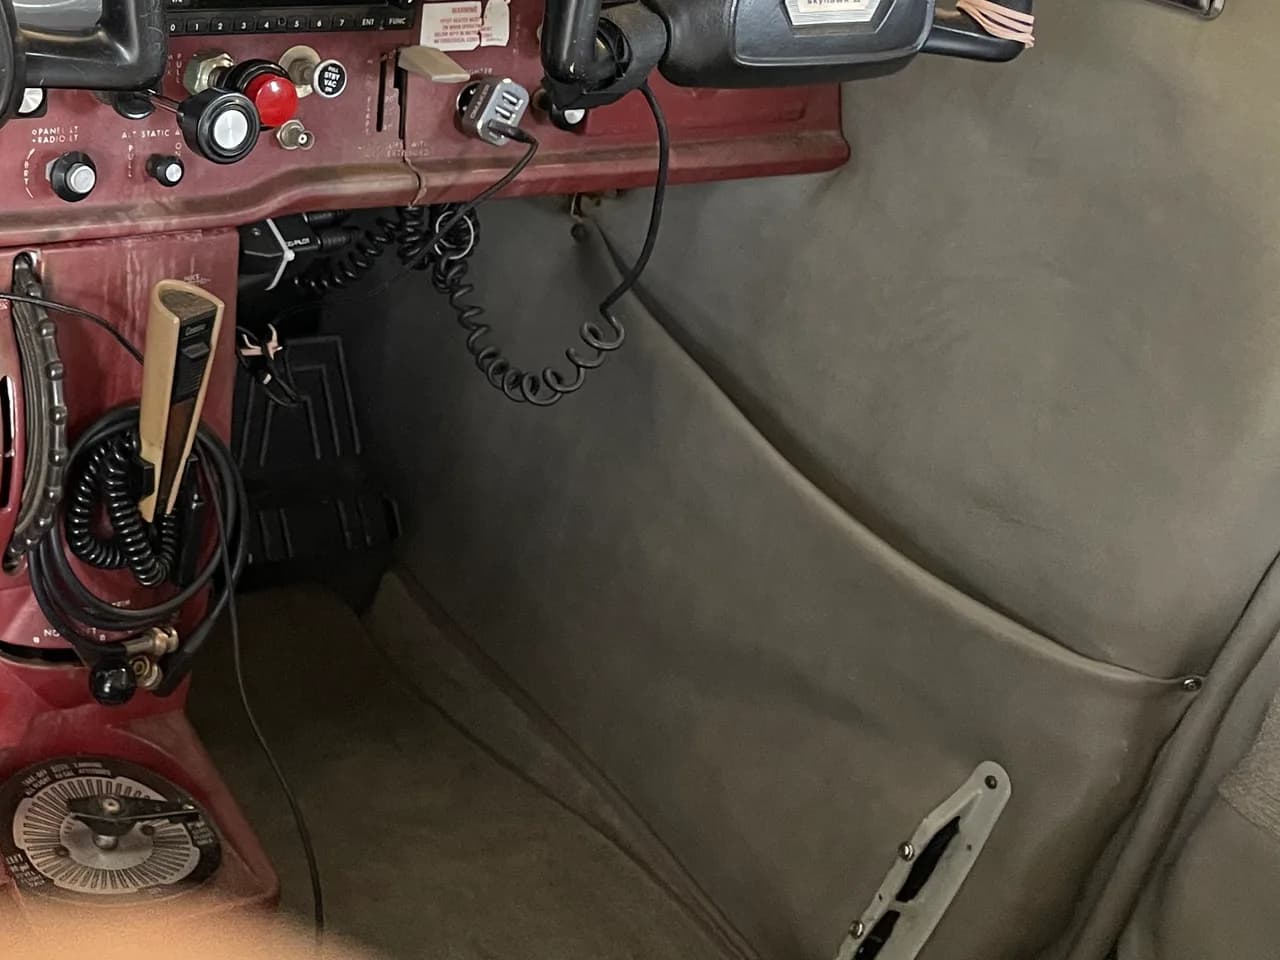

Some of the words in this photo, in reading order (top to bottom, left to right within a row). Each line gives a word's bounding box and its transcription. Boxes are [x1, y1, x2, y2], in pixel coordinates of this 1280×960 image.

[362, 18, 375, 26] ENT
[389, 17, 407, 25] FUNC
[324, 72, 341, 80] STBY
[324, 80, 337, 88] VAC
[141, 129, 170, 138] STATIC
[38, 135, 66, 143] RADIO
